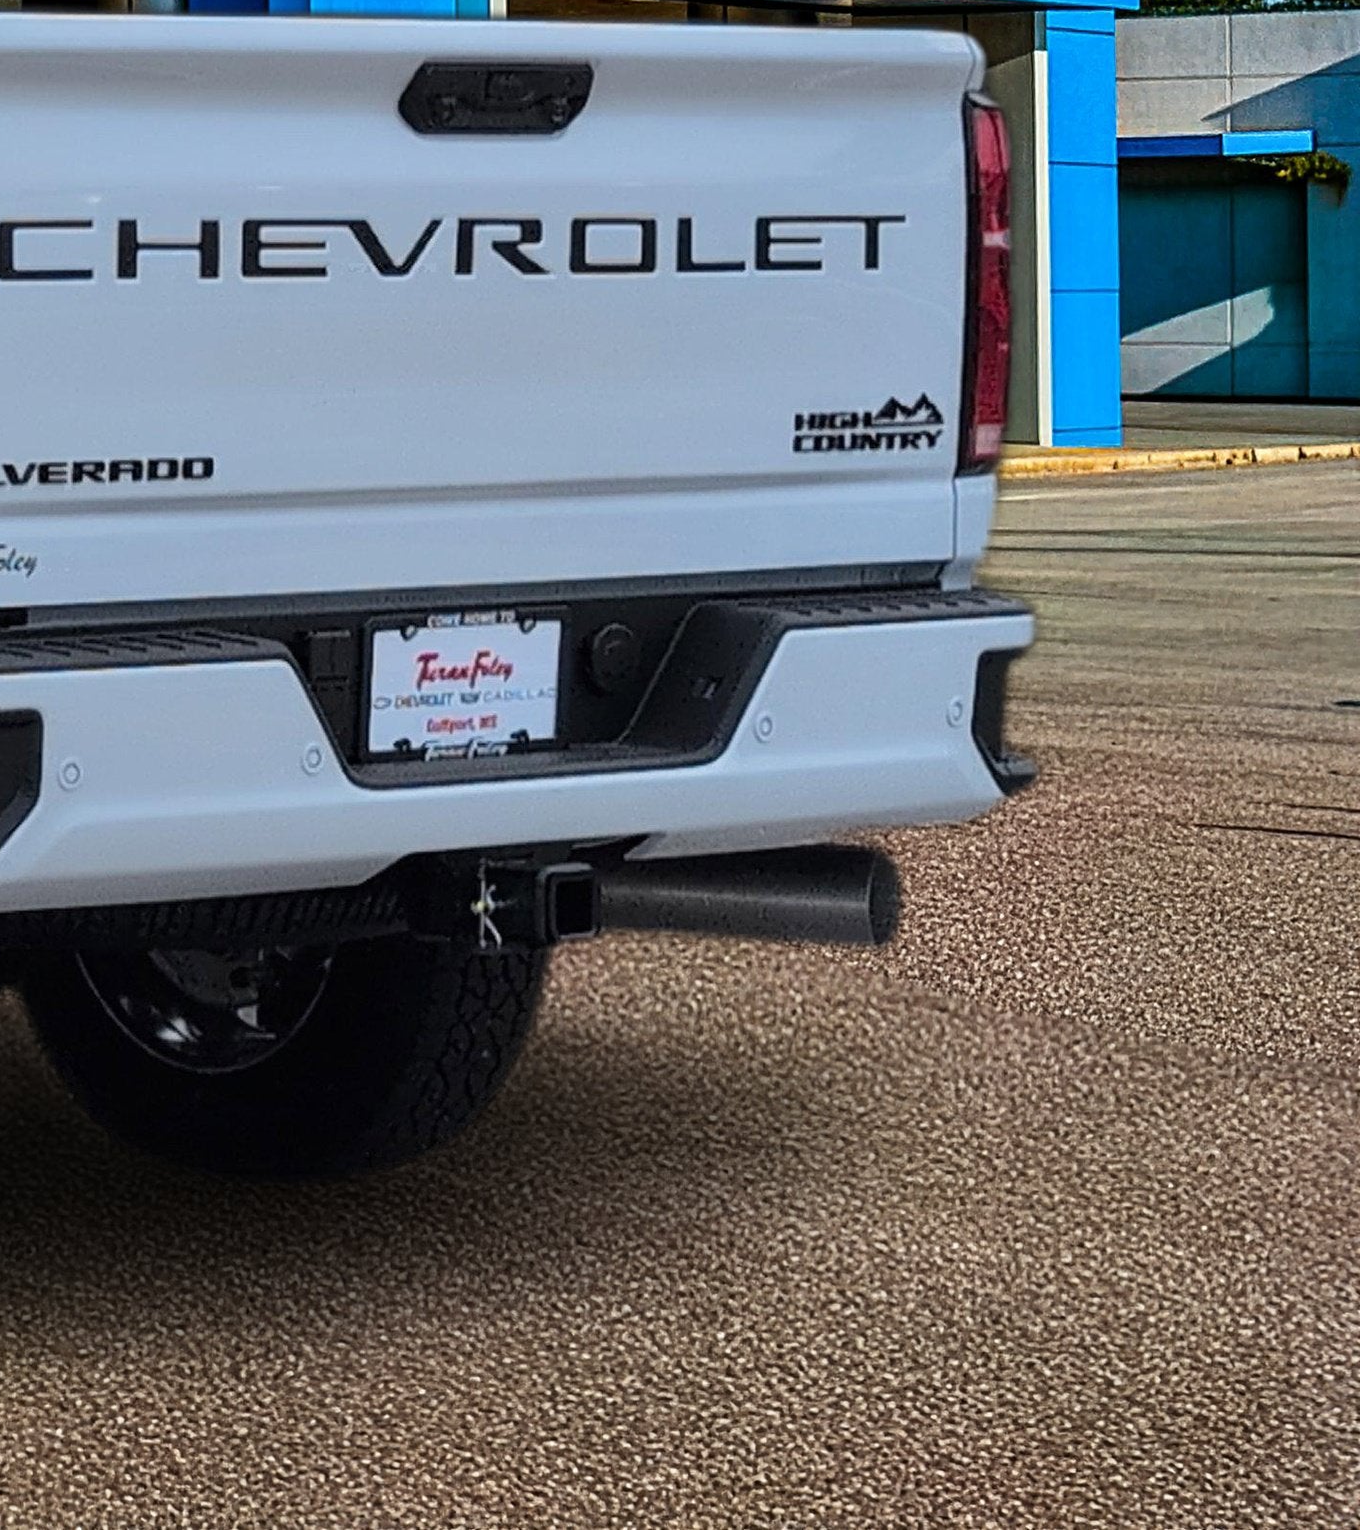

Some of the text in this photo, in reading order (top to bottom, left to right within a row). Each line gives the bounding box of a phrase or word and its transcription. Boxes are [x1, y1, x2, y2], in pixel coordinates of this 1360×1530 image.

[794, 411, 873, 432] HIGH
[792, 429, 943, 453] COUNTRY
[483, 687, 557, 703] CADILLAC
